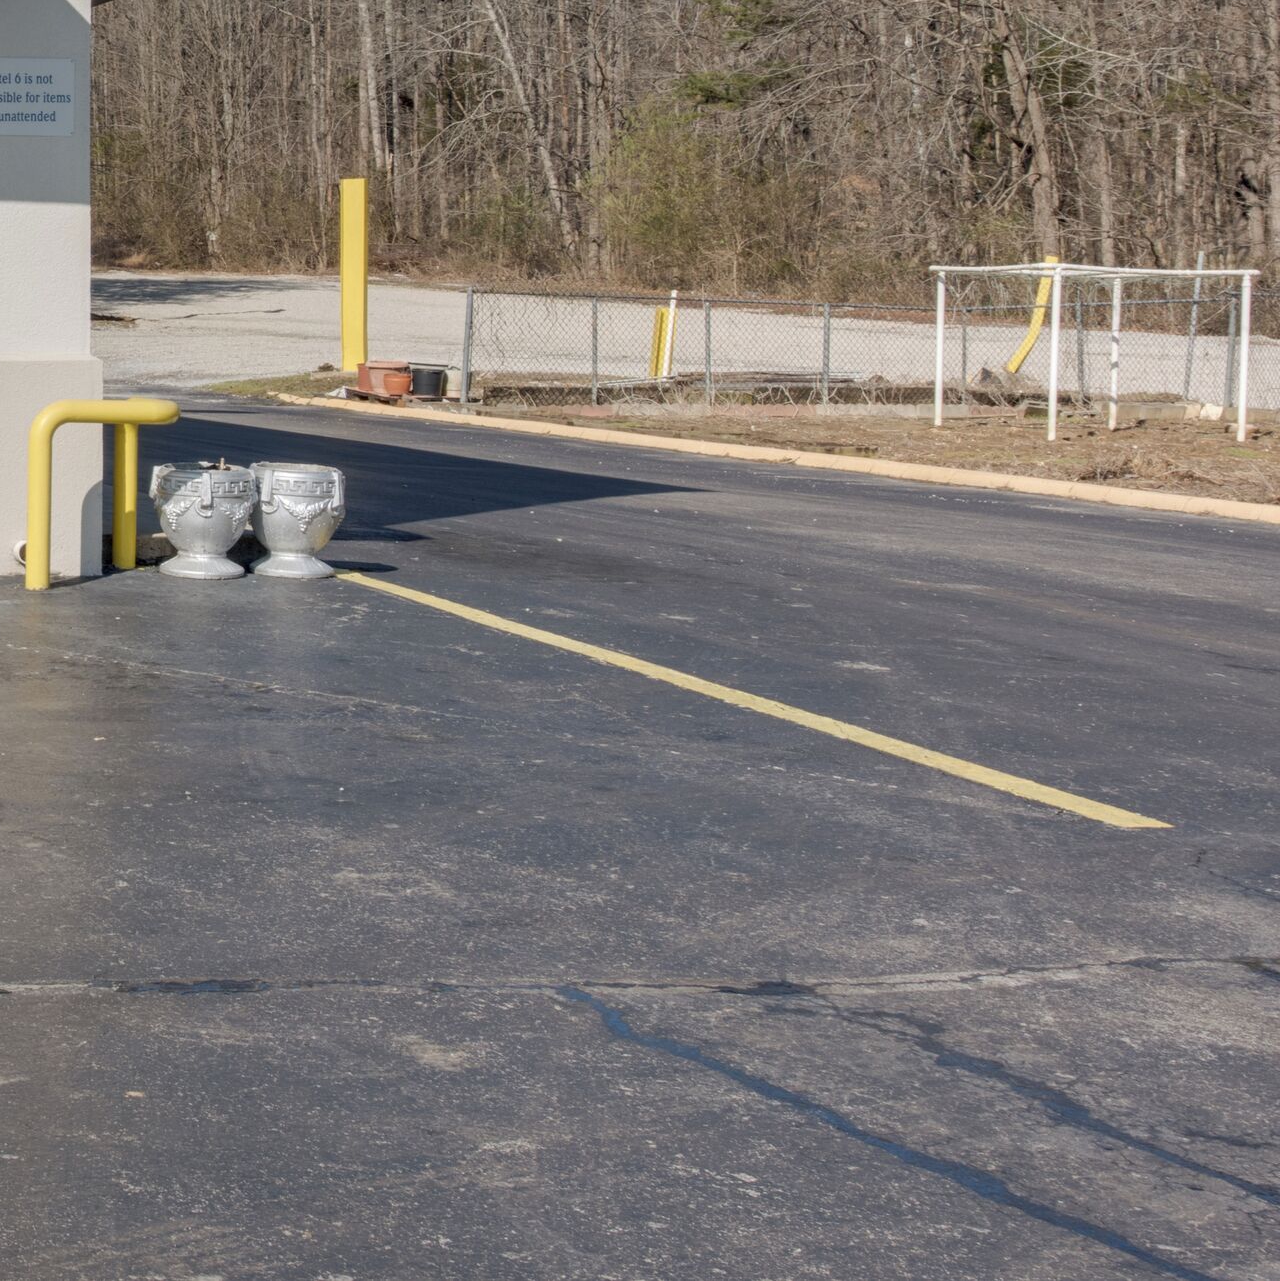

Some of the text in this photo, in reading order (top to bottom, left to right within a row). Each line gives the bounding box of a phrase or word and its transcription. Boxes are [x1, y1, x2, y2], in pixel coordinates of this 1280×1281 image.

[14, 72, 21, 84] 6
[24, 73, 33, 84] is
[36, 74, 53, 84] not
[25, 92, 40, 103] for
[43, 92, 72, 103] items
